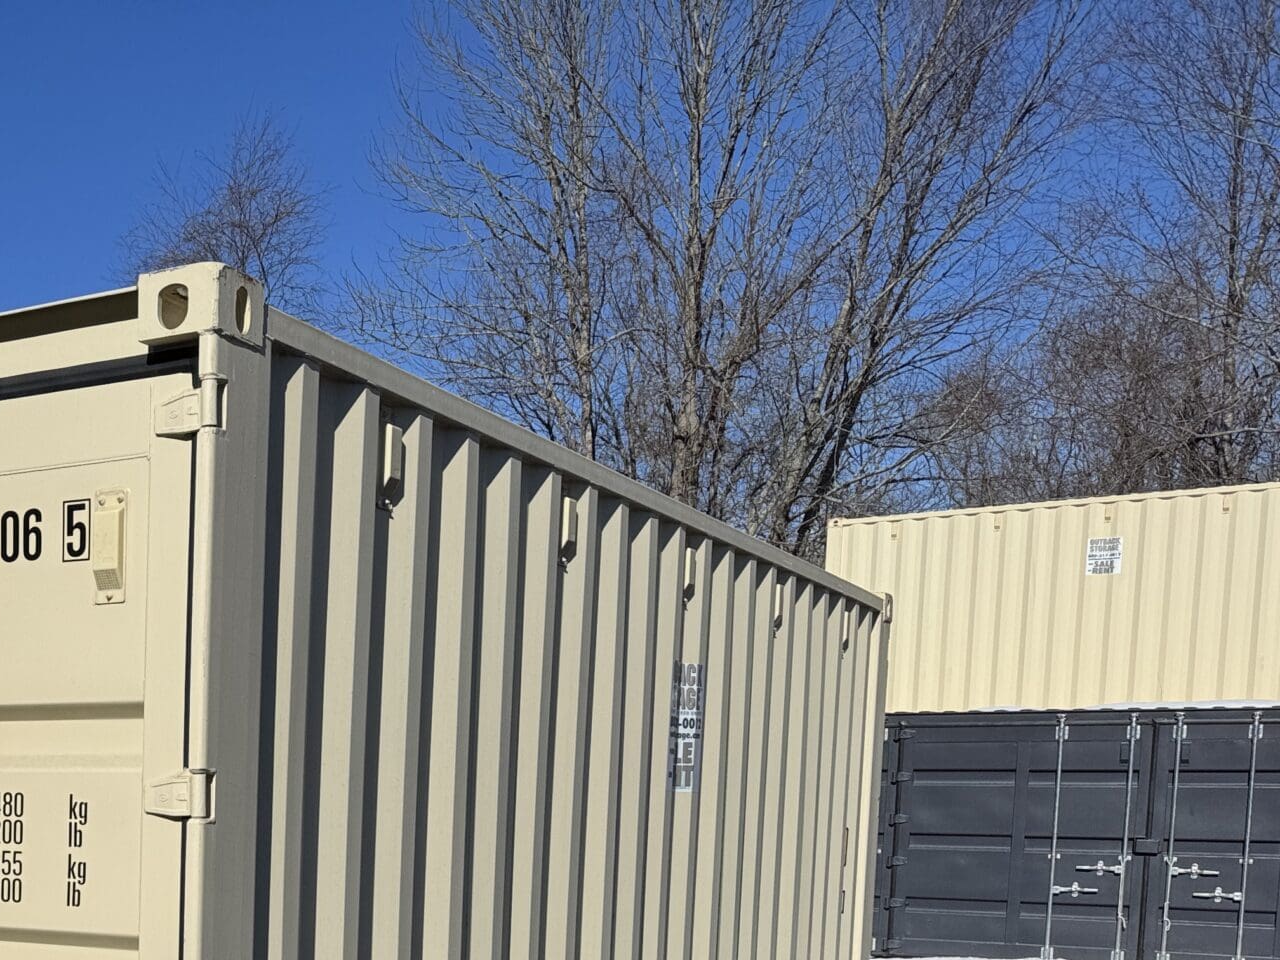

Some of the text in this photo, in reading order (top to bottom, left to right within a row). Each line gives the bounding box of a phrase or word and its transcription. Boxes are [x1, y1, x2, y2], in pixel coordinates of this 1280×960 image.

[65, 502, 88, 560] 5
[69, 793, 88, 825] kg
[68, 822, 83, 848] lb
[67, 853, 87, 885] kg
[67, 881, 81, 907] lb
